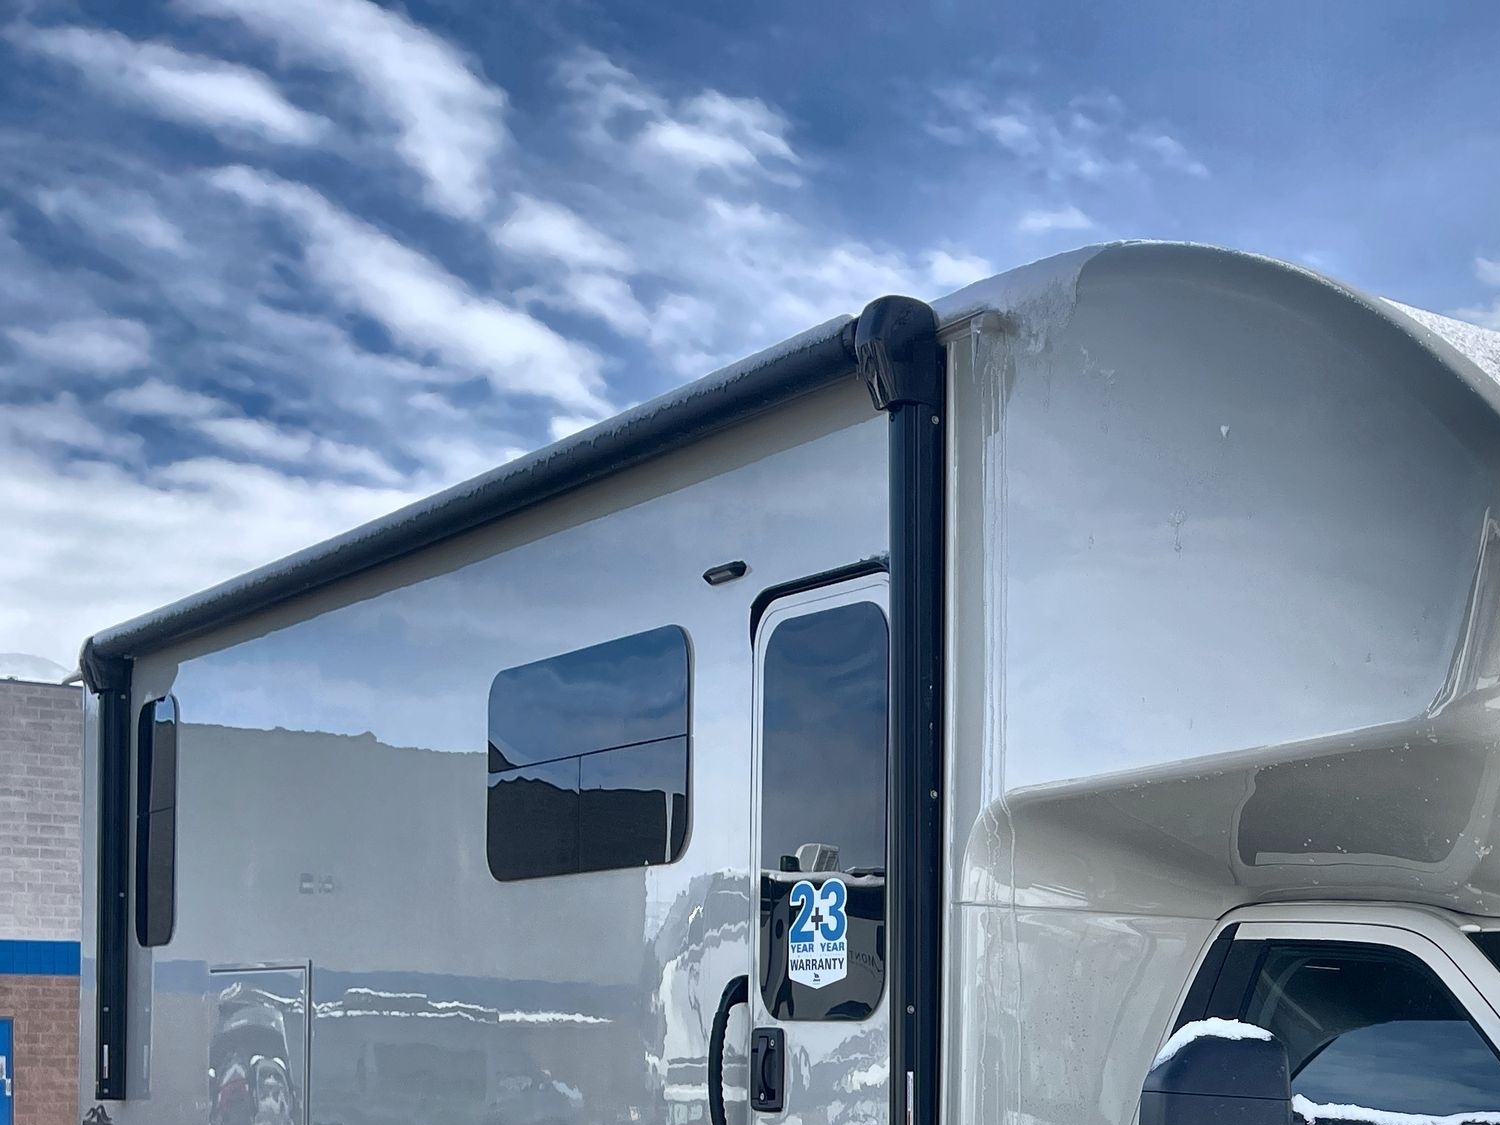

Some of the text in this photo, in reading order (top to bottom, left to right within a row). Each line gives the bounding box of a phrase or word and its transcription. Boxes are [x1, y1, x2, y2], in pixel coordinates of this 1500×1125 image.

[790, 941, 845, 953] YEAR YEAR
[790, 957, 844, 971] WARRANTY
